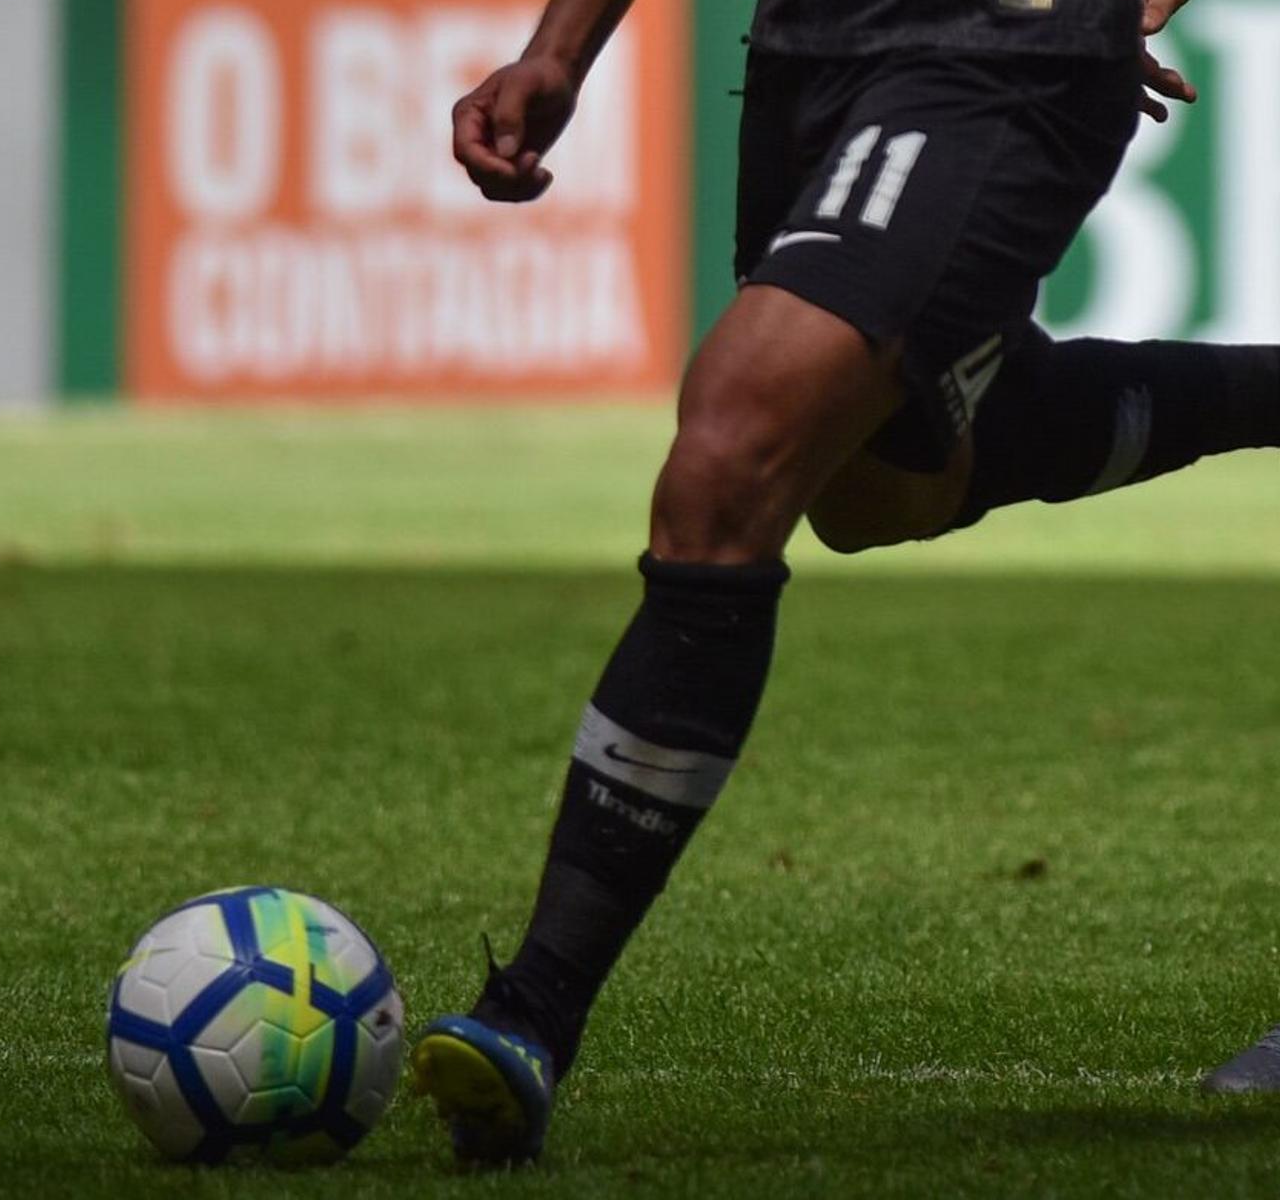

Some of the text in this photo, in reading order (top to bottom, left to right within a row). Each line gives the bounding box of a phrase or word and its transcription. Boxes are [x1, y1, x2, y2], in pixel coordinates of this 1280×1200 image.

[165, 4, 282, 216] O
[816, 125, 928, 230] 11
[167, 228, 650, 382] CONTAGIA
